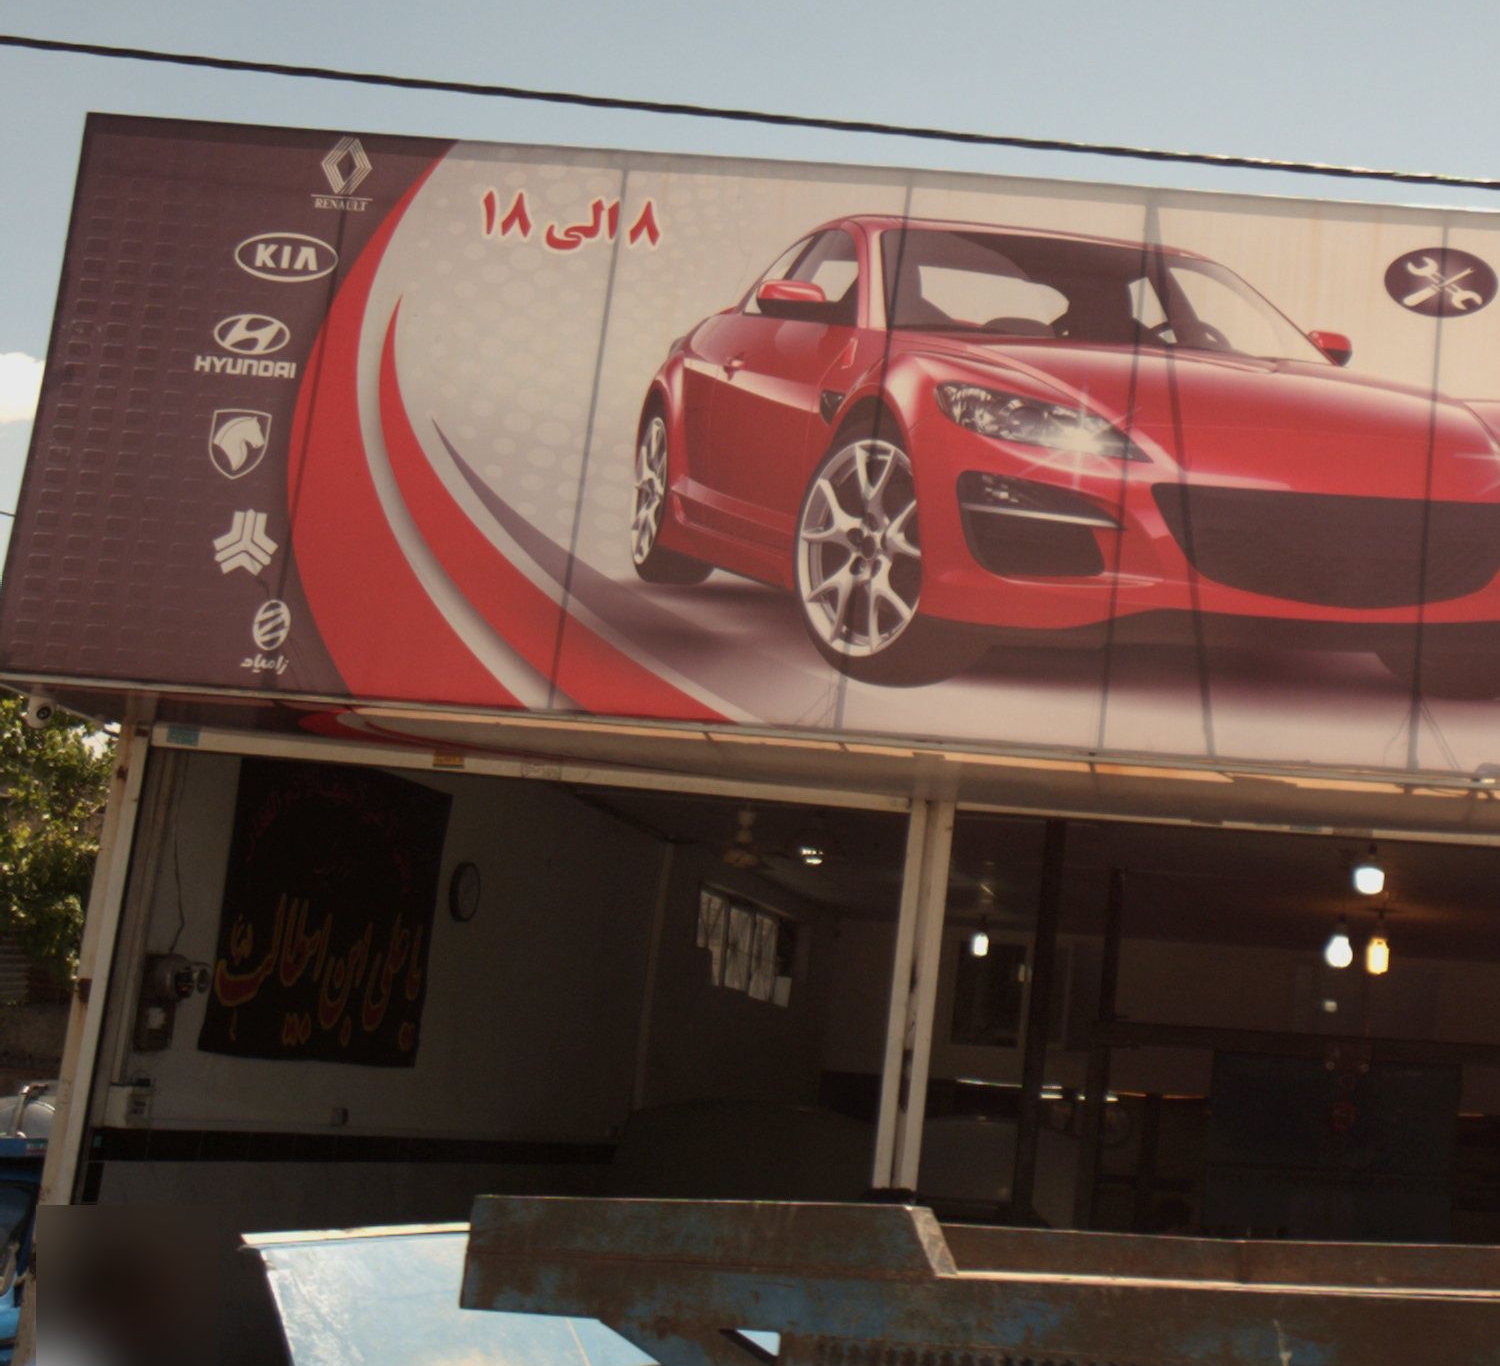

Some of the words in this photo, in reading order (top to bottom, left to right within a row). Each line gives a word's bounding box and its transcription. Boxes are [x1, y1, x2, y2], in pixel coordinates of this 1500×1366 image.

[313, 198, 368, 212] RENAULT
[483, 190, 532, 239] ۱۸
[546, 198, 621, 250] الی
[629, 200, 660, 246] ۸
[254, 243, 319, 272] KIA
[194, 355, 297, 379] HYUNDAI
[240, 653, 289, 676] زامیاد
